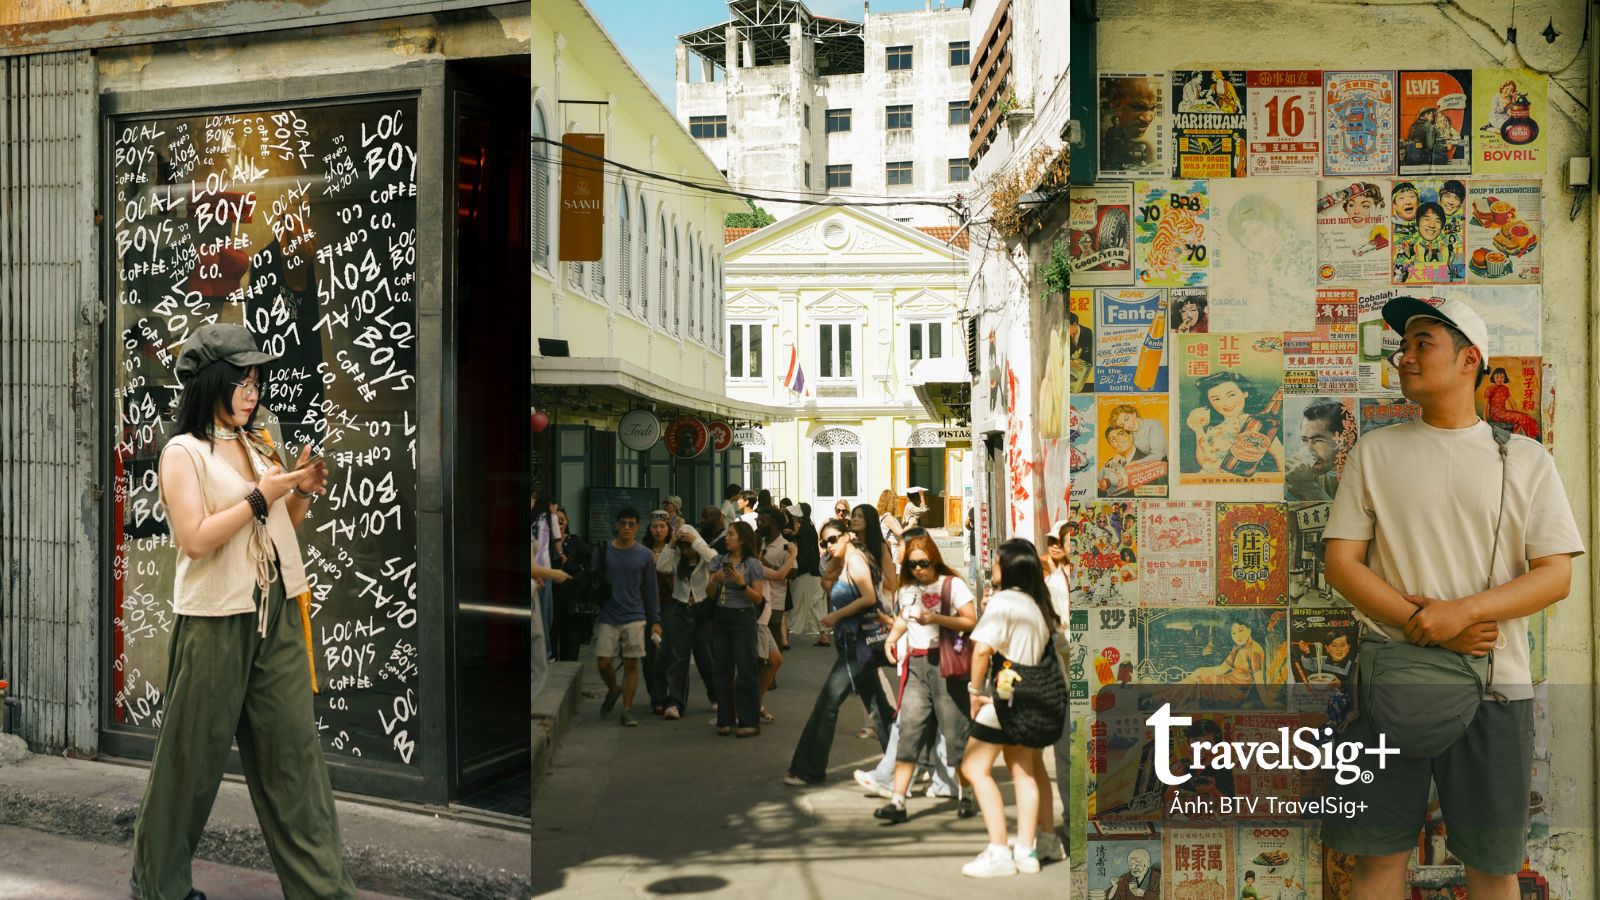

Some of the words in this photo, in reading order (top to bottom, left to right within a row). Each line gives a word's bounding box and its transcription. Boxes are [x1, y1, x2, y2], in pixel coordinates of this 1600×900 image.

[206, 115, 241, 129] LOCAL
[243, 118, 253, 137] CO.
[361, 110, 404, 148] LOC
[1172, 114, 1247, 129] MARIHUANA
[1265, 95, 1304, 137] 16
[206, 128, 234, 143] BOYS
[269, 111, 295, 161] BOYS
[116, 144, 154, 173] BOYS
[168, 155, 201, 183] LOCAL
[170, 143, 196, 169] BOYS
[204, 158, 214, 166] CO.
[191, 157, 269, 203] LOCAL
[324, 155, 354, 184] BOYS
[322, 167, 359, 199] LOCAL
[194, 191, 257, 234] BOYS
[262, 179, 312, 226] LOCAL
[336, 204, 363, 224] CO.
[1139, 205, 1160, 222] YO
[271, 200, 311, 243] BOYS
[370, 212, 396, 230] CO.
[116, 218, 174, 260] BOYS
[200, 233, 253, 256] COFFEE.
[169, 254, 201, 281] LOCAL
[171, 242, 197, 268] BOYS
[249, 249, 273, 269] CO.
[286, 255, 305, 270] CO.
[119, 258, 170, 282] COFFEE.
[200, 263, 222, 280] CO.
[317, 248, 382, 306] BOYS
[120, 290, 141, 305] CO.
[311, 276, 393, 340] LOCAL
[394, 291, 412, 303] CO.
[1359, 290, 1393, 304] Cobalah
[242, 294, 291, 334] BOY
[1108, 305, 1157, 323] Fanta
[353, 326, 416, 391] BOYS
[1187, 342, 1209, 376] 啤酒
[1219, 335, 1240, 368] 北平
[269, 366, 312, 382] LOCAL
[316, 361, 337, 391] CO.
[269, 383, 304, 402] BOYS
[309, 392, 361, 432] LOCAL
[301, 409, 346, 447] BOYS
[365, 421, 391, 437] CO.
[328, 466, 399, 511] BOYS
[315, 505, 401, 547] LOCAL
[1149, 514, 1162, 525] 14
[137, 561, 160, 575] CO.
[321, 616, 386, 646] LOCAL
[325, 643, 375, 677] BOYS
[330, 675, 373, 690] COFFEE.
[329, 698, 349, 711] CO.
